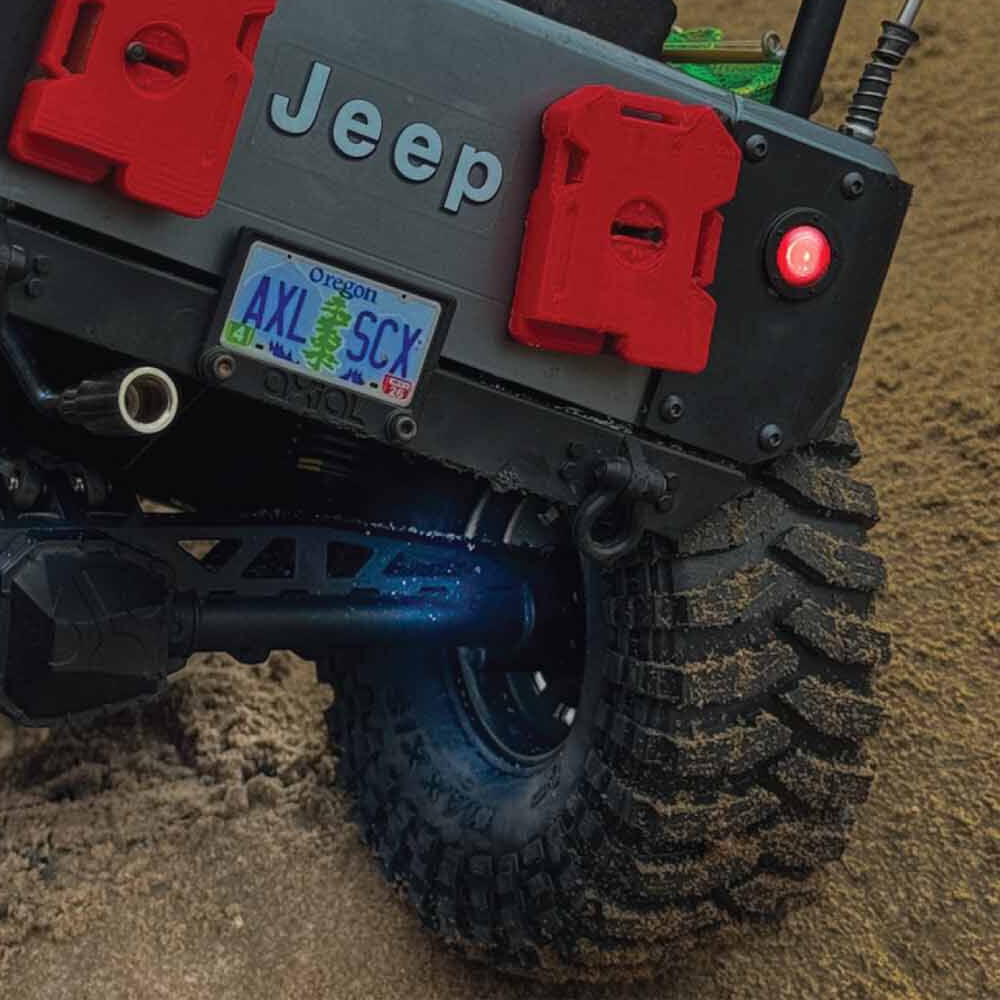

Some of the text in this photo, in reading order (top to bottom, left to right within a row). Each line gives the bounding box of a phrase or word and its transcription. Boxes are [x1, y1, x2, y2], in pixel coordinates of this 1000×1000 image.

[269, 61, 503, 214] Jeep
[241, 275, 423, 379] AXL SCX
[308, 266, 379, 304] Oregon
